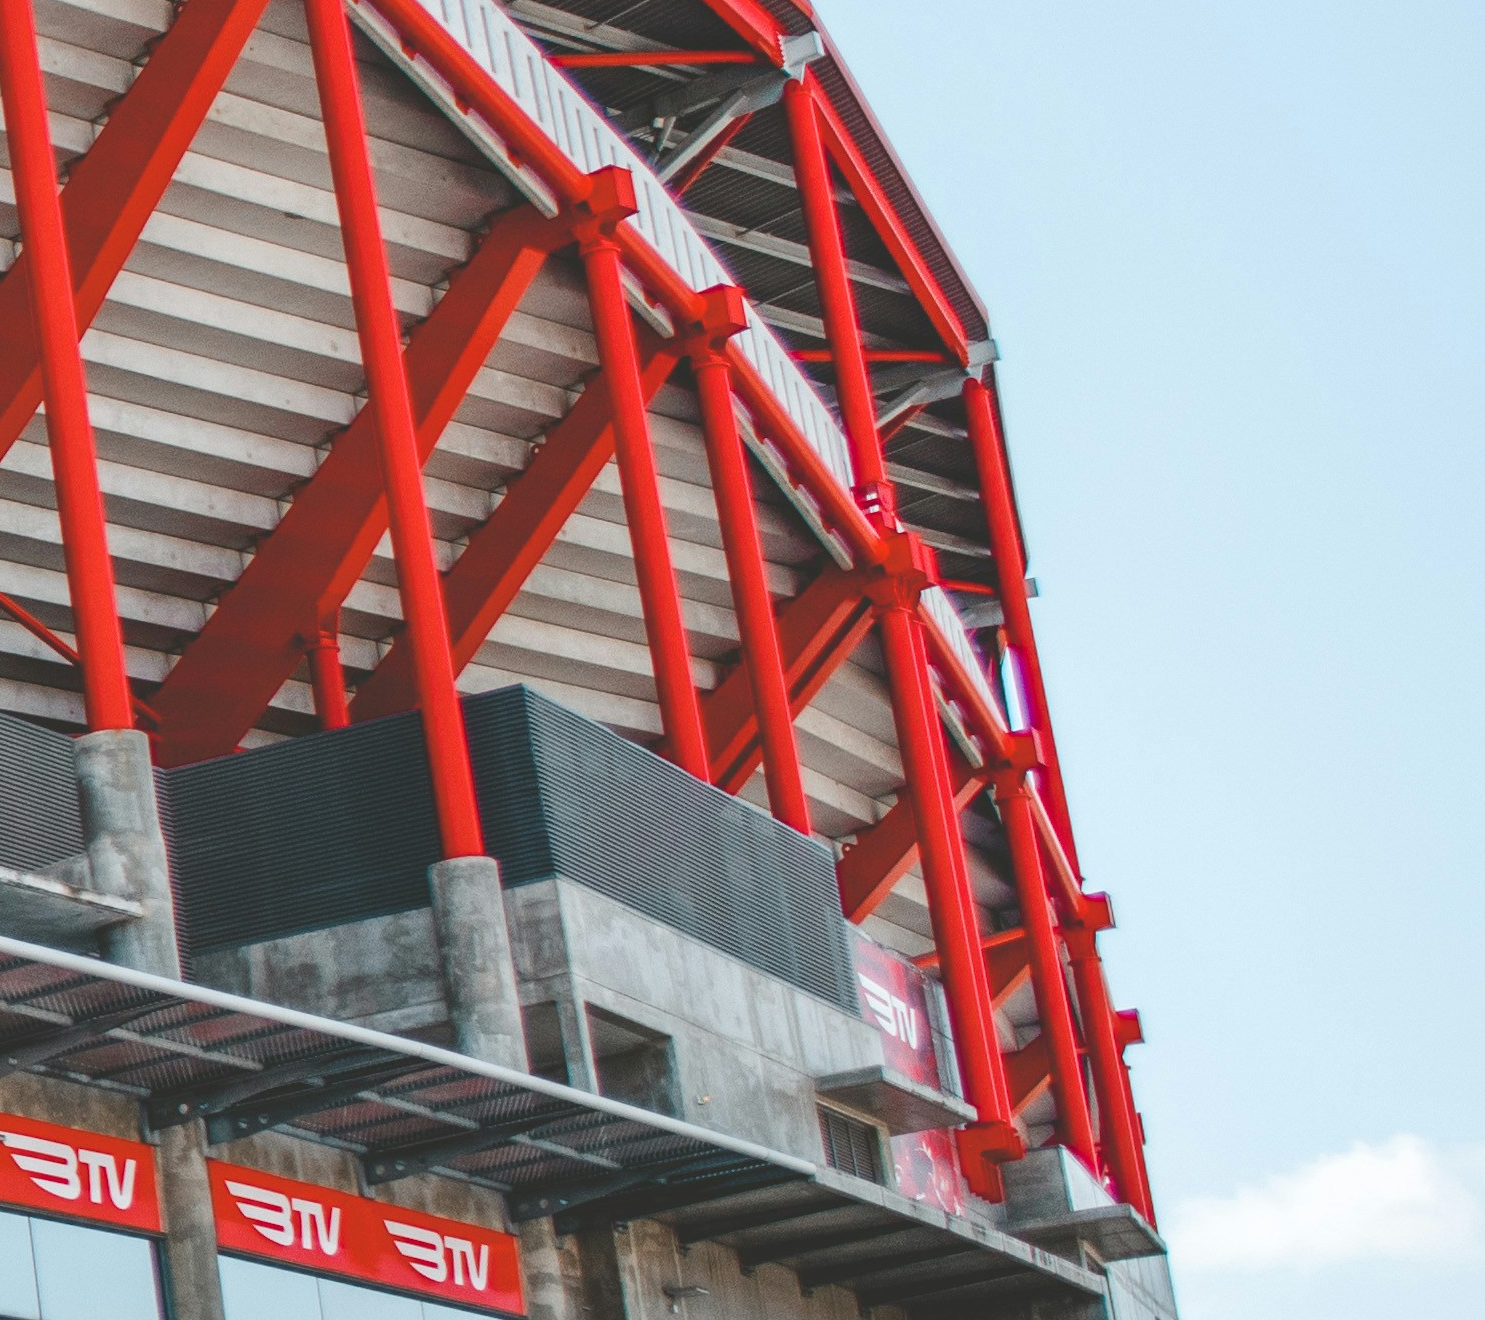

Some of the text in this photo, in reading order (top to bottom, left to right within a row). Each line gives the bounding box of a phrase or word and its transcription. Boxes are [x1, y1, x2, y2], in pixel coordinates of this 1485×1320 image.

[857, 973, 919, 1051] BTV
[2, 1132, 137, 1211] BTV
[224, 1180, 342, 1257] BTV
[383, 1219, 490, 1292] BTV
